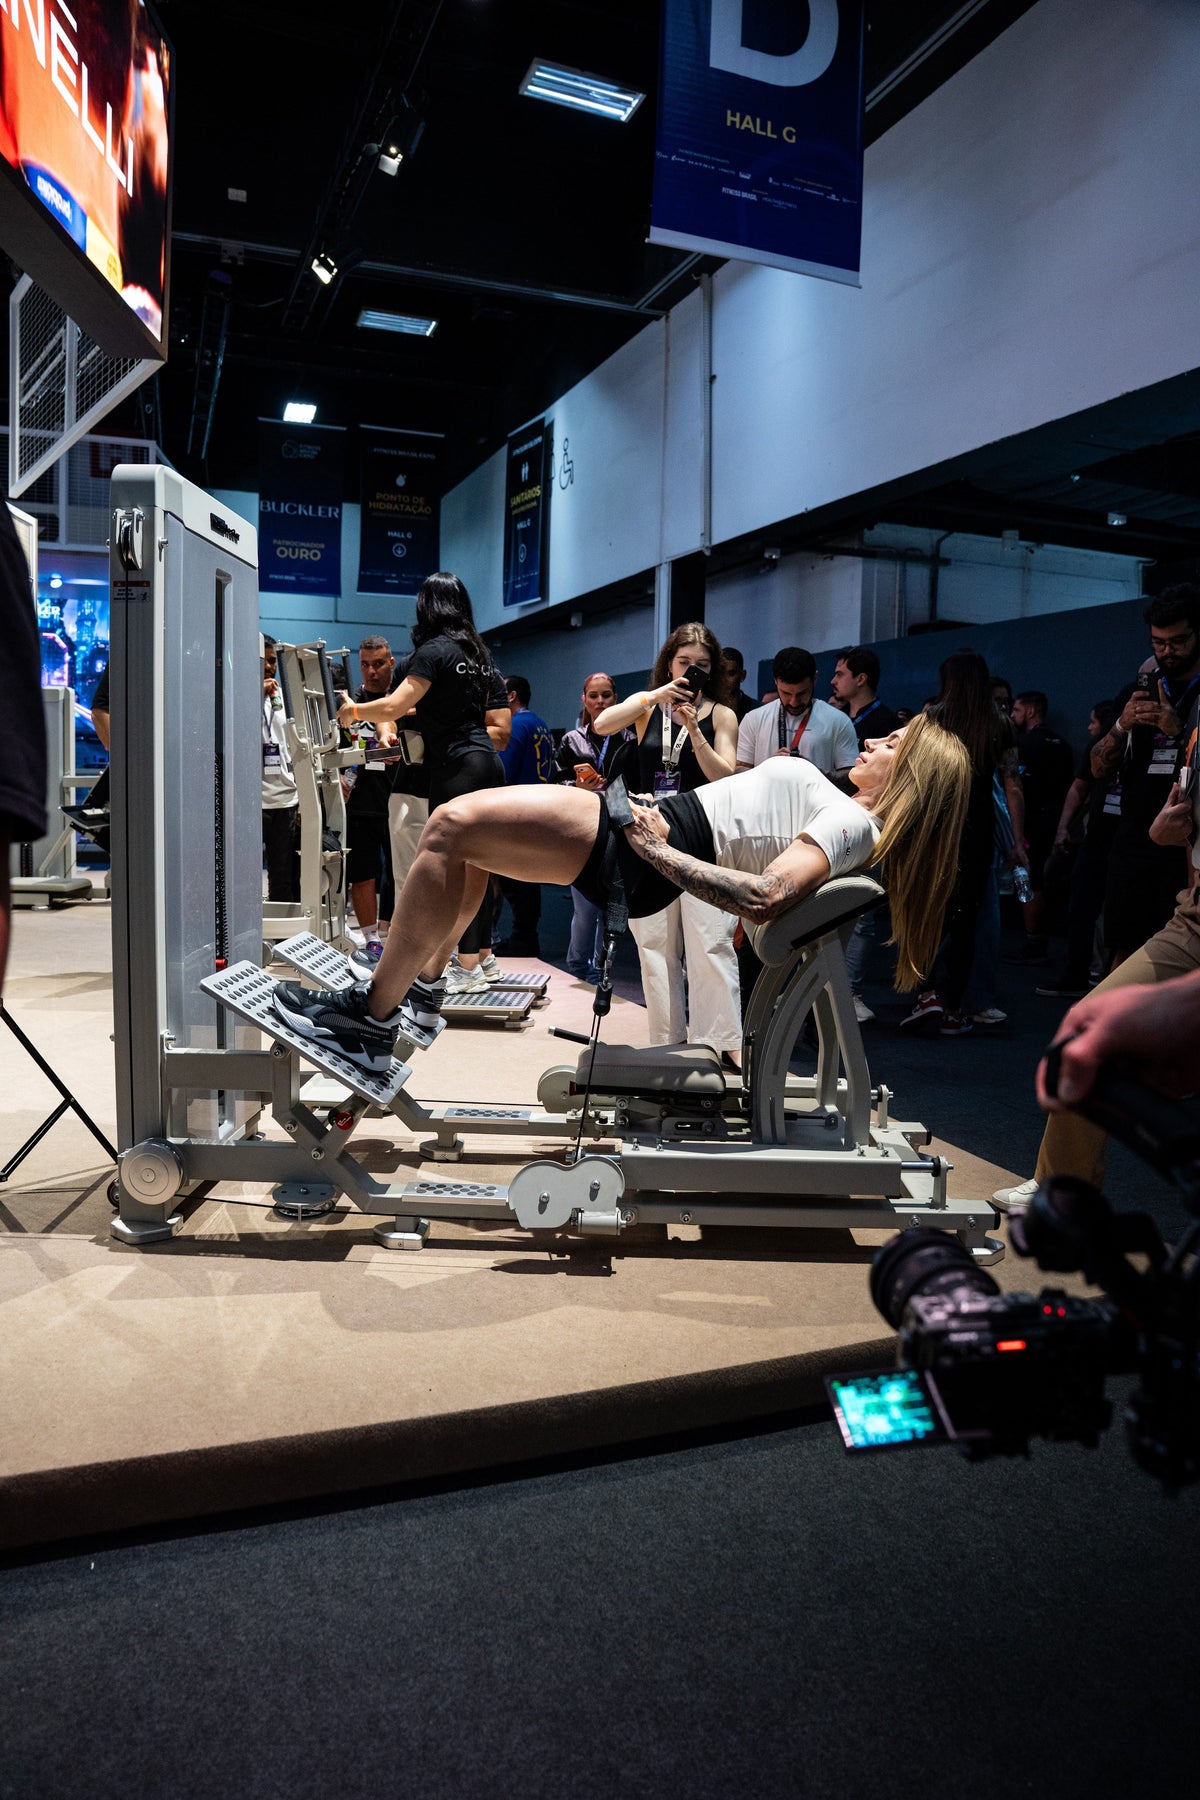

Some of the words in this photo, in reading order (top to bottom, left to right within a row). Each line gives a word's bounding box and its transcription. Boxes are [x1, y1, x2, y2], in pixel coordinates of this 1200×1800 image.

[0, 0, 134, 198] NELLI
[726, 109, 777, 139] HALL
[782, 126, 797, 144] G
[376, 492, 410, 503] PONTO
[412, 496, 425, 505] DE
[260, 500, 340, 518] BUCKLER
[387, 530, 405, 539] HALL
[276, 546, 322, 561] OURO
